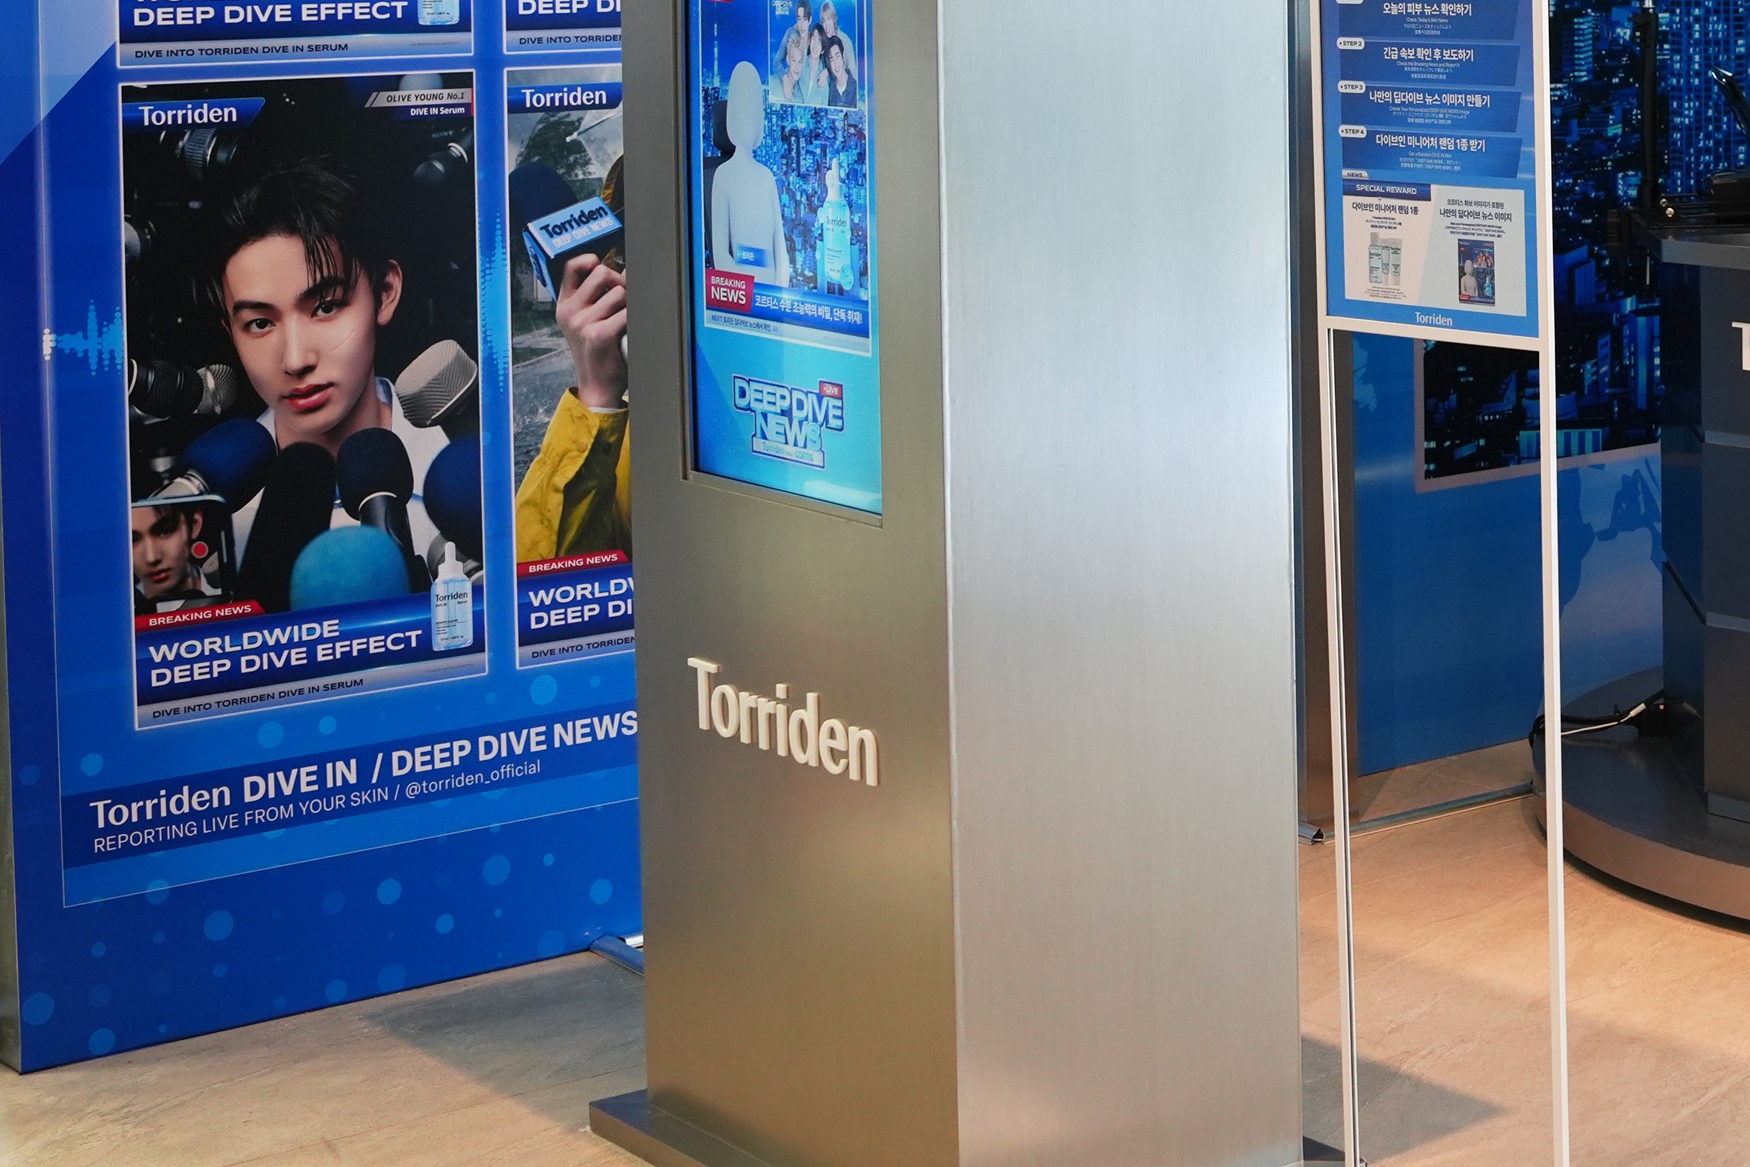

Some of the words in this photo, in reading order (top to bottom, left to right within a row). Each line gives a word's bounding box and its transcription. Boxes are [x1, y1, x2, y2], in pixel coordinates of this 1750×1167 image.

[133, 4, 215, 27] DEEP
[223, 3, 292, 24] DIVE
[300, 0, 409, 22] EFFECT
[1383, 3, 1406, 15] 오늘의
[1407, 3, 1423, 16] 피부
[1424, 3, 1440, 15] 뉴스
[1441, 3, 1472, 17] 확인하기
[135, 48, 161, 59] DIVE
[165, 48, 195, 58] INTO
[197, 46, 259, 57] TORRIDEN
[262, 45, 289, 56] DIVE
[292, 44, 305, 54] IN
[307, 43, 349, 53] SERUM
[1383, 47, 1399, 60] 긴급
[1400, 47, 1415, 60] 속보
[1416, 47, 1432, 61] 확인
[1433, 48, 1442, 61] 후
[1443, 48, 1474, 62] 보도하기
[521, 86, 608, 108] Torriden
[1369, 91, 1392, 103] 나만의
[1394, 92, 1424, 105] 딥다이브
[1425, 92, 1441, 105] 뉴스
[1442, 93, 1465, 106] 이미지
[1467, 94, 1491, 108] 만들기
[139, 103, 237, 127] Torriden
[1376, 135, 1406, 148] 다이브인
[1407, 135, 1437, 149] 미니어처
[1439, 136, 1454, 150] 랜덤
[1456, 137, 1468, 151] 1종
[1469, 138, 1486, 152] 받기
[1356, 184, 1385, 193] SPECIAL
[1386, 186, 1417, 195] REWARD
[540, 205, 608, 239] Torriden
[1440, 209, 1457, 219] 나만의
[1458, 210, 1481, 221] 딥다이브
[1482, 211, 1494, 221] 뉴스
[1494, 212, 1512, 223] 이미지
[711, 275, 746, 289] BREAKING
[711, 286, 747, 305] NEWS
[1415, 311, 1453, 327] Torriden
[733, 376, 791, 414] DEEP
[791, 389, 843, 429] DIVE
[755, 411, 821, 452] NEWS
[529, 559, 584, 573] BREAKING
[586, 554, 618, 565] NEWS
[149, 609, 211, 627] BREAKING
[214, 604, 252, 618] NEWS
[149, 619, 340, 663] WORLDWIDE
[150, 658, 232, 689] DEEP
[239, 648, 308, 673] DIVE
[317, 629, 422, 661] EFFECT
[152, 708, 180, 719] DIVE
[183, 702, 213, 714] INTO
[215, 693, 276, 709] TORRIDEN
[279, 688, 306, 699] DIVE
[308, 685, 321, 695] IN
[323, 678, 364, 692] SERUM
[687, 657, 880, 786] Torriden
[90, 782, 231, 830] Torriden
[243, 762, 319, 804] DIVE
[324, 757, 358, 792] IN
[371, 753, 384, 785] /
[392, 738, 471, 780] DEEP
[478, 728, 547, 762] DIVE
[553, 709, 639, 749] NEWS
[94, 818, 198, 854] REPORTING
[203, 812, 239, 835] LIVE
[245, 804, 294, 828] FROM
[299, 794, 346, 819] YOUR
[351, 786, 389, 810] SKIN
[405, 759, 541, 801] @torriden_official
